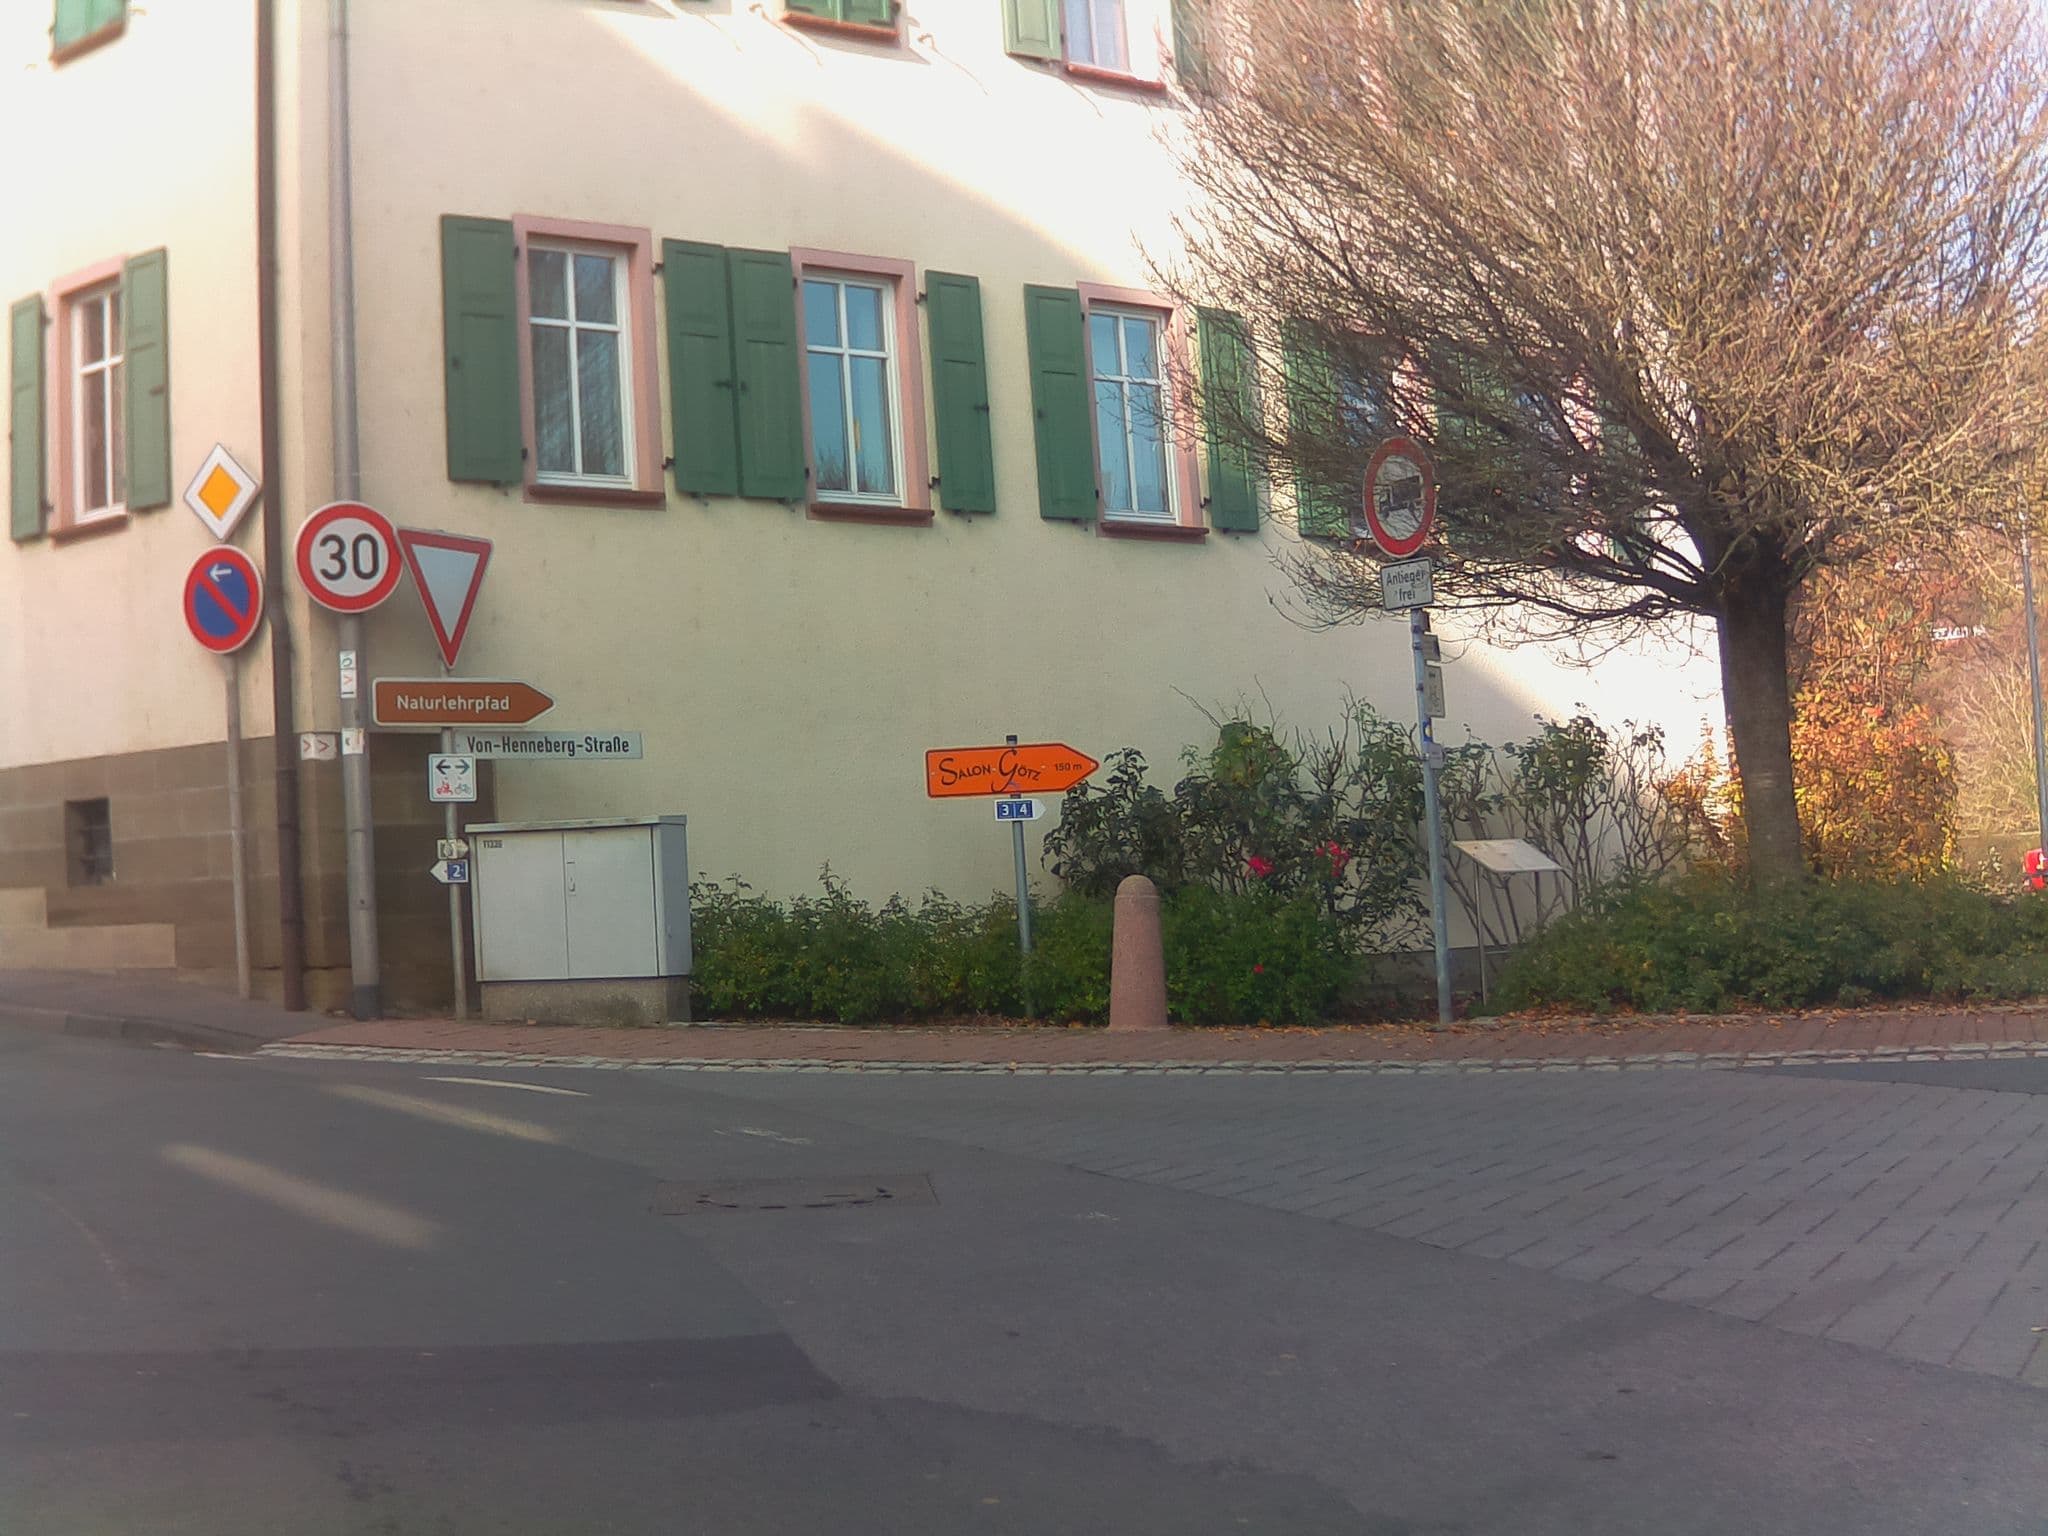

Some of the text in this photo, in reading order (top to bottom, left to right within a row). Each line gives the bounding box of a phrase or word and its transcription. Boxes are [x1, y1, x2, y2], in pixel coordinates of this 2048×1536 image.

[319, 533, 379, 581] 30
[1386, 570, 1425, 587] Anlieger
[1399, 588, 1416, 601] frei
[396, 694, 511, 714] Naturlehrpfad
[466, 734, 630, 757] Von-Henneberg-Straße
[1054, 762, 1071, 772] 150
[1072, 763, 1082, 771] m
[1001, 803, 1028, 817] 3 4
[452, 864, 462, 878] 2
